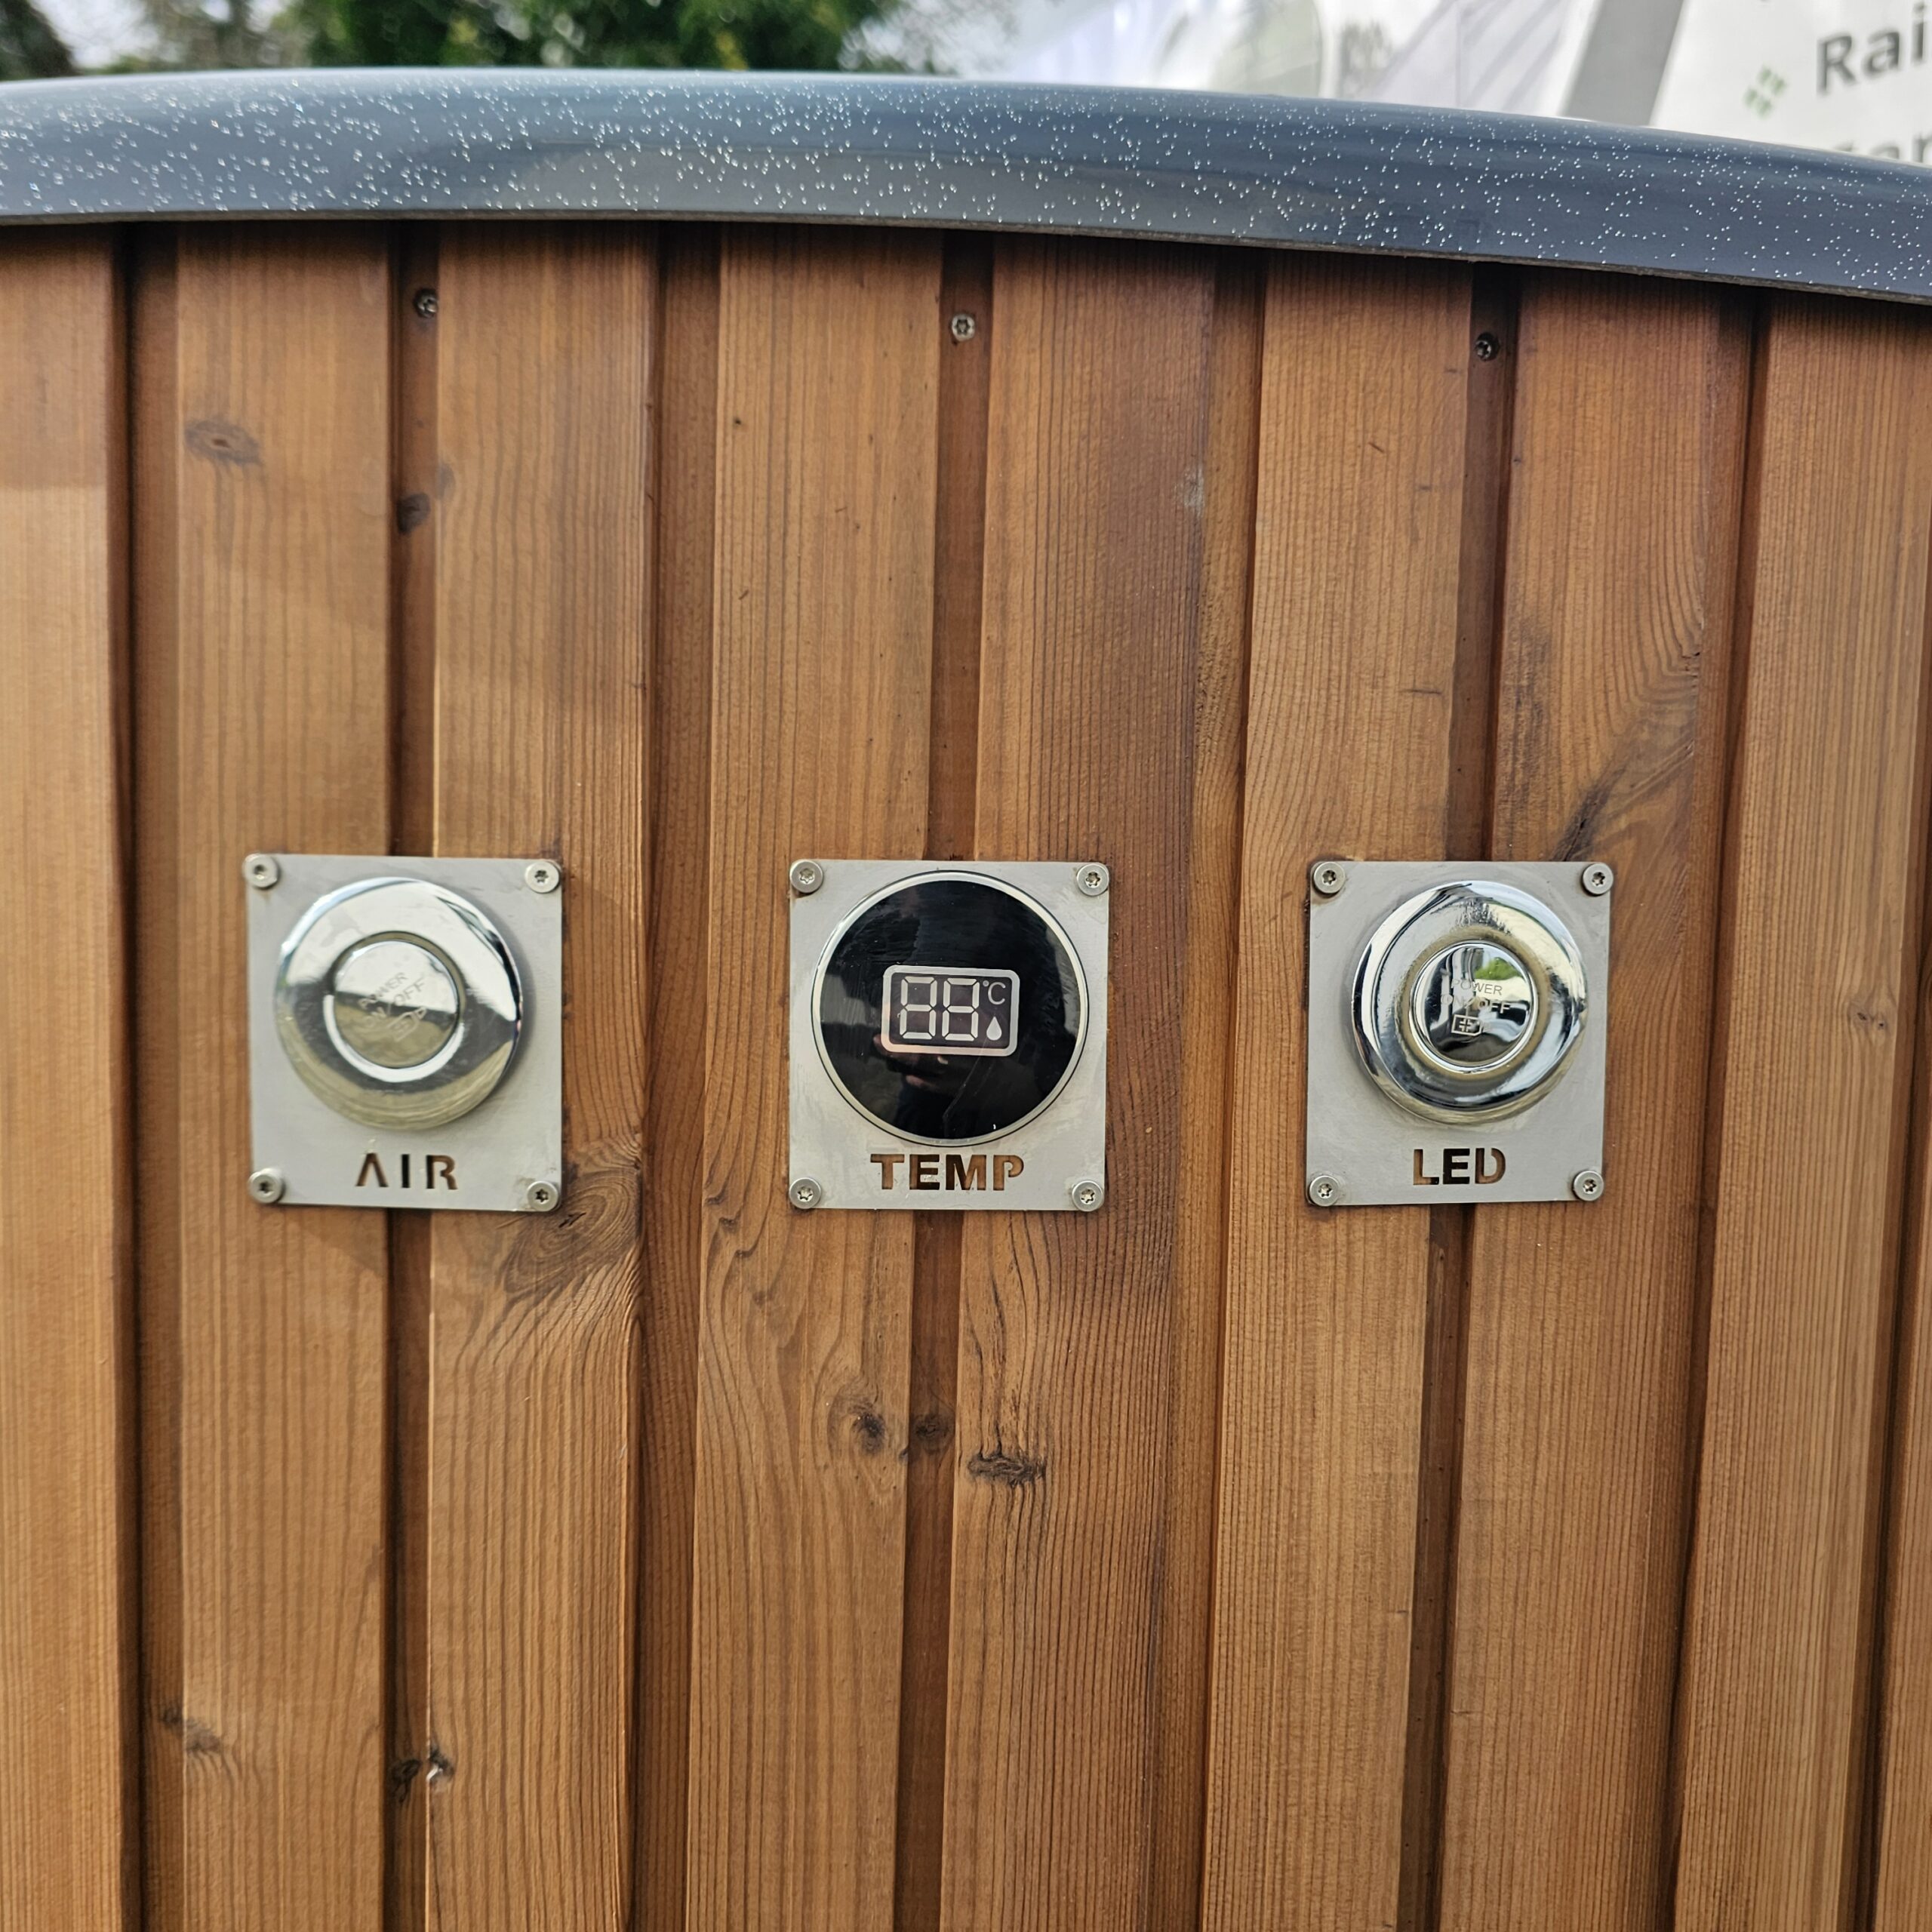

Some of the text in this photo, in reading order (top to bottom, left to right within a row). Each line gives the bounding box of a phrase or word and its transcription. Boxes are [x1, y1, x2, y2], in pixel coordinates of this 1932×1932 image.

[1451, 979, 1503, 995] POWER
[355, 1152, 458, 1190] AIR
[870, 1154, 1024, 1191] TEMP
[1413, 1148, 1506, 1186] LED
